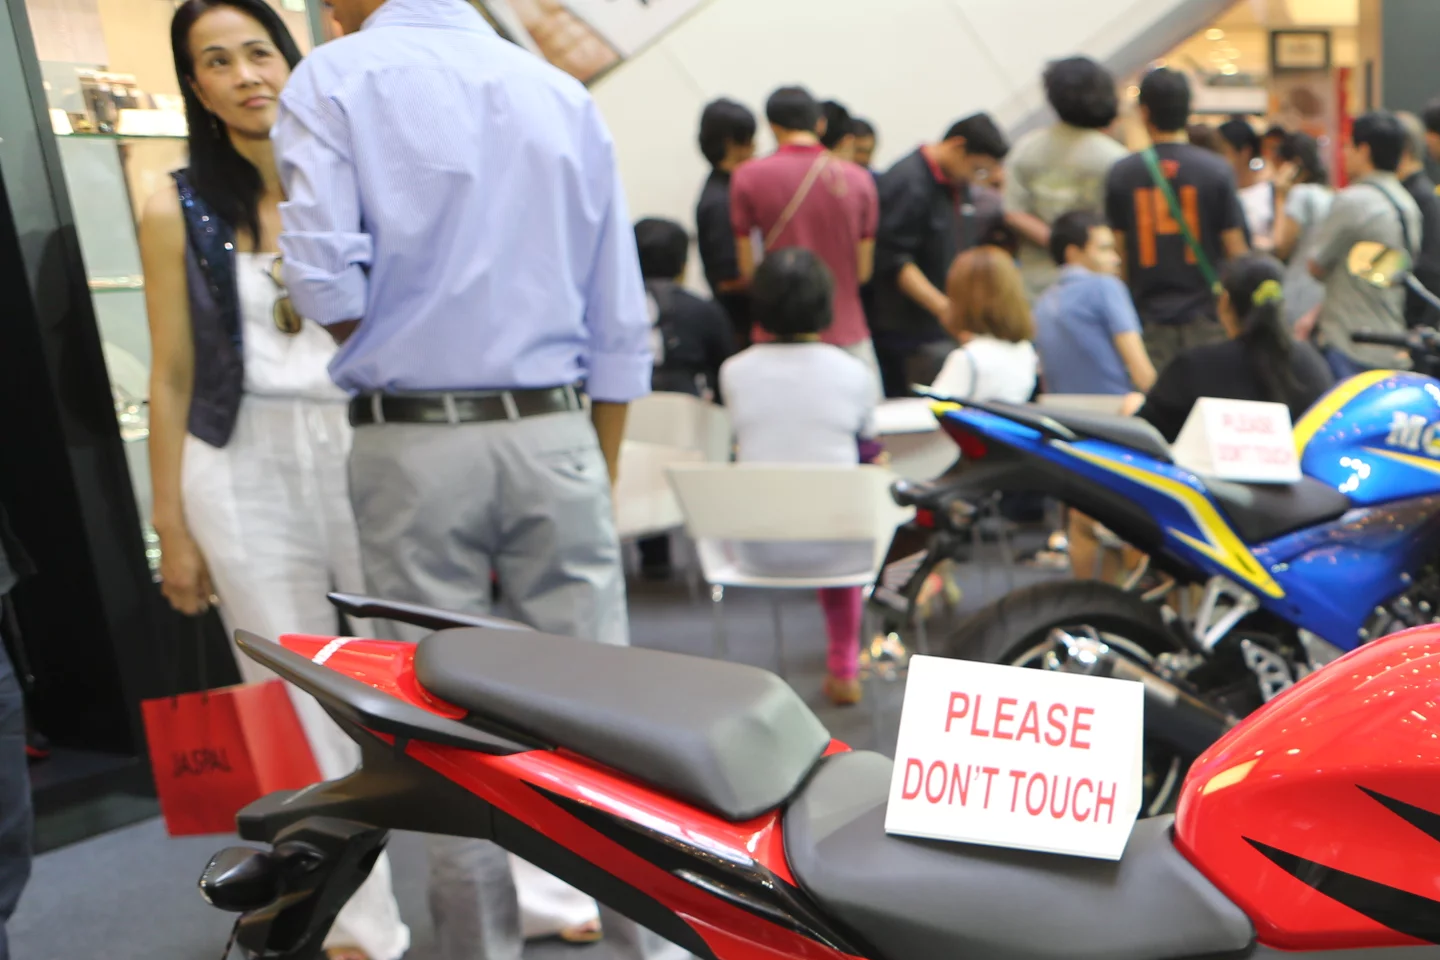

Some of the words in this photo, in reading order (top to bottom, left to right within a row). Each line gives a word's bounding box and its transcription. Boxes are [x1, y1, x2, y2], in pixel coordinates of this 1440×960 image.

[944, 691, 1095, 750] PLEASE
[901, 757, 999, 809] DON'T
[1009, 770, 1117, 824] TOUCH
